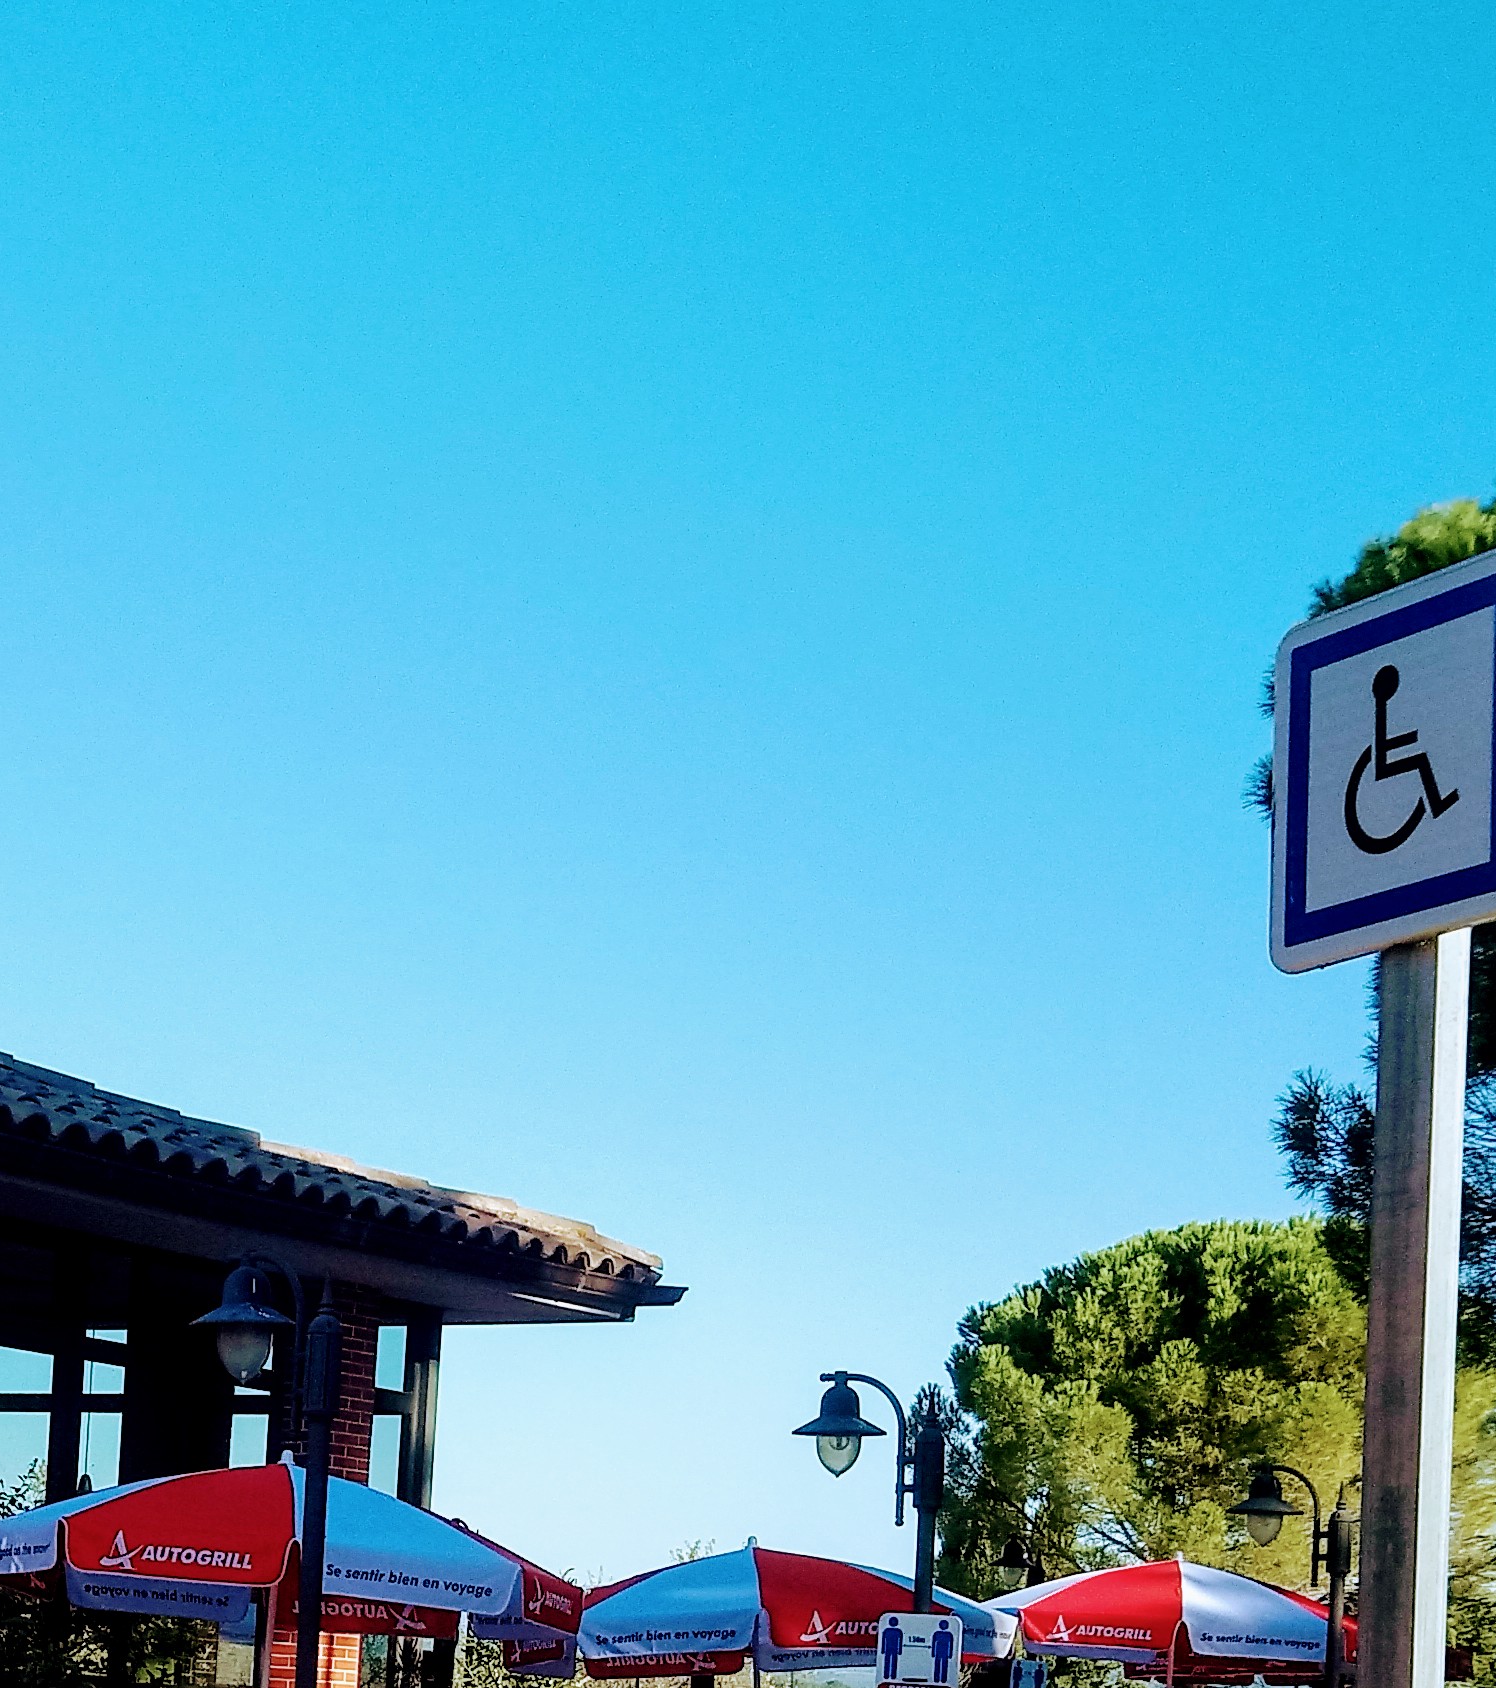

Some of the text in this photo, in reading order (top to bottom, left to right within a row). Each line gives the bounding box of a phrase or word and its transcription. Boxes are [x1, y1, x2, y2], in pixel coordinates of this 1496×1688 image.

[141, 1545, 252, 1570] AUTOGRILL
[325, 1563, 494, 1599] Se sentir bien en voyage
[595, 1629, 737, 1646] Se sentir bien en voyage
[1075, 1624, 1153, 1641] AUTOGRILL
[1200, 1632, 1321, 1650] Se sentir bien en voyage
